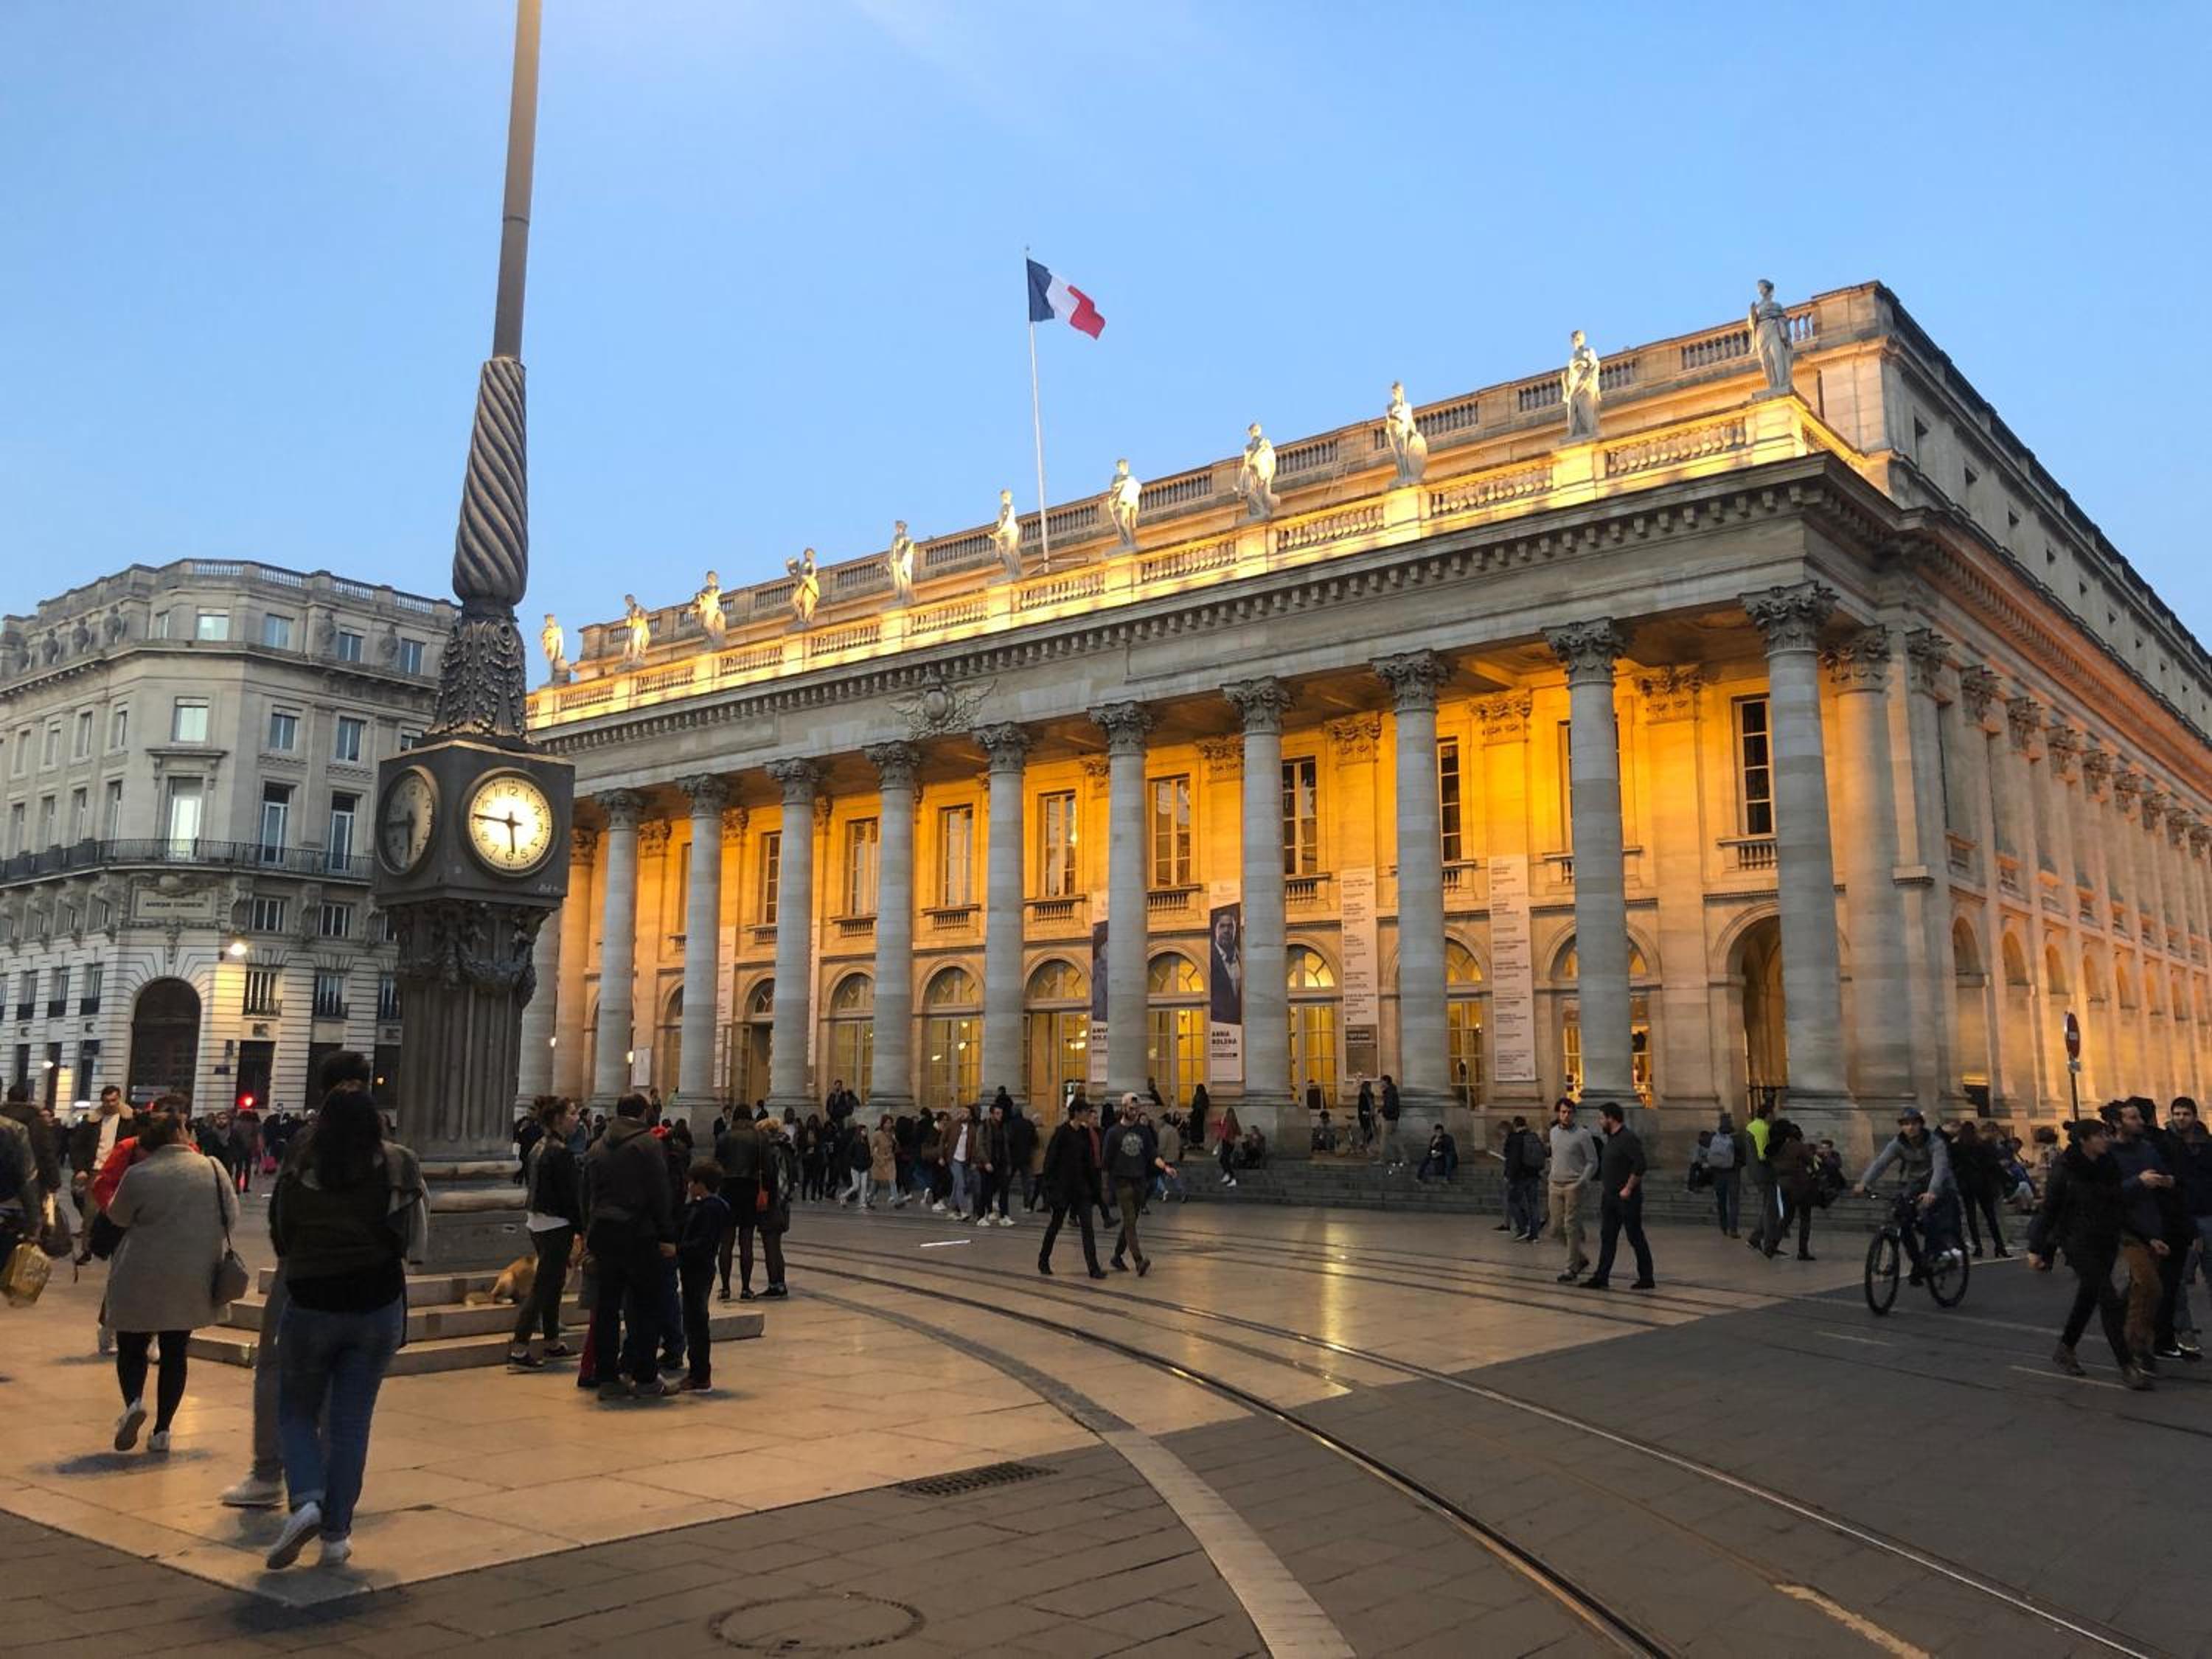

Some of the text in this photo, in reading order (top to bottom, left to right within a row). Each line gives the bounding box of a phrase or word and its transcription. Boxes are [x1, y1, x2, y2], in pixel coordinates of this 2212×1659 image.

[495, 787, 501, 799] 11
[507, 786, 518, 797] 12
[481, 799, 493, 810] 10
[533, 805, 542, 815] 2
[536, 822, 543, 832] 3
[530, 837, 538, 847] 4
[492, 844, 499, 855] 7
[520, 849, 529, 859] 5
[505, 850, 514, 861] 6
